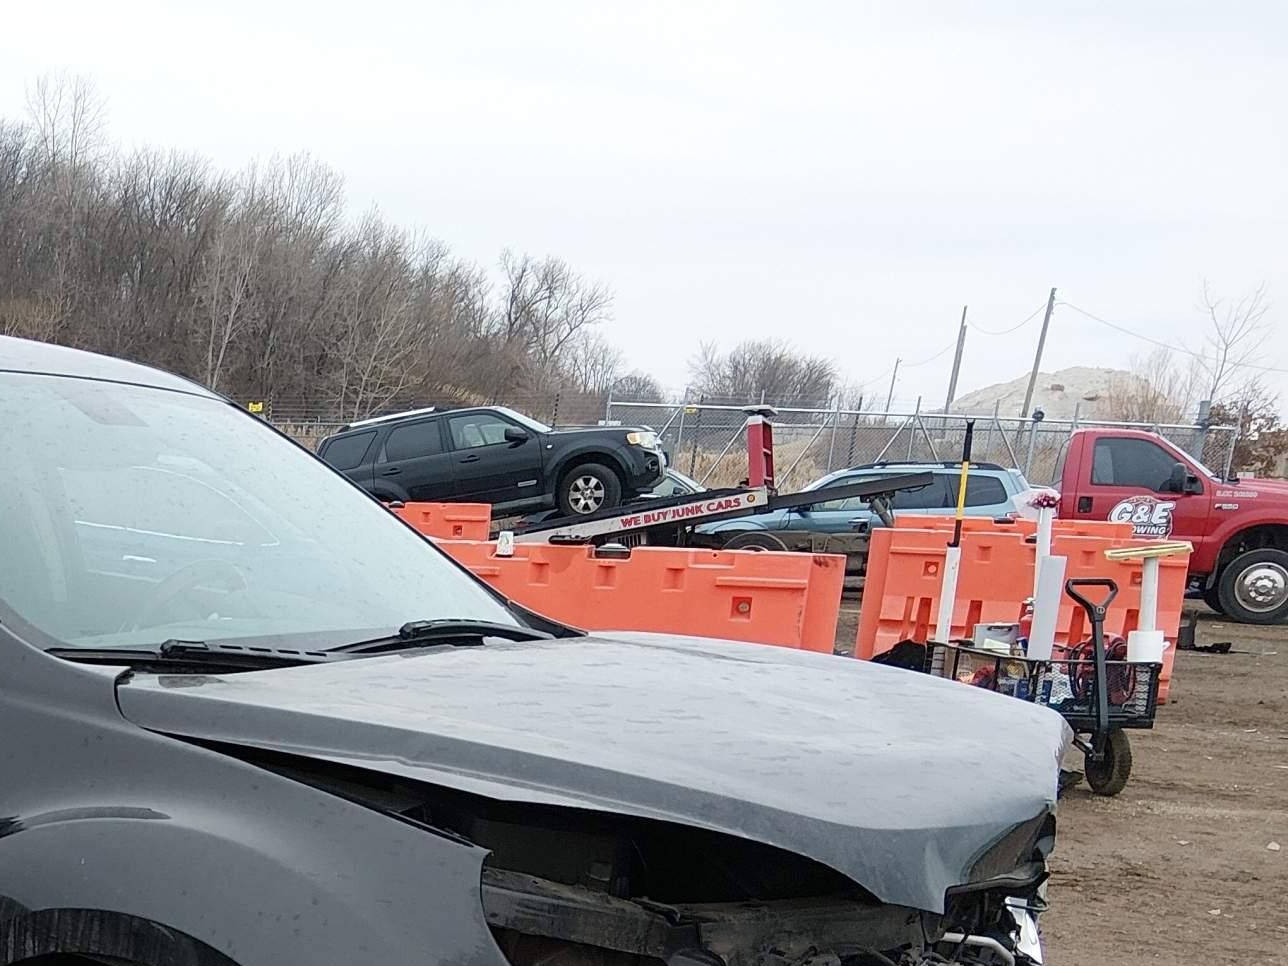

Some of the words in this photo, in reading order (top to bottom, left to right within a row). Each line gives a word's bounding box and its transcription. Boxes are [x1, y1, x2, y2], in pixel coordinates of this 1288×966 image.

[621, 516, 642, 527] WE
[643, 511, 669, 524] BUY
[672, 504, 704, 518] JUNK
[706, 498, 741, 512] CARS
[1110, 501, 1175, 524] G&E
[1132, 526, 1166, 535] OWING
